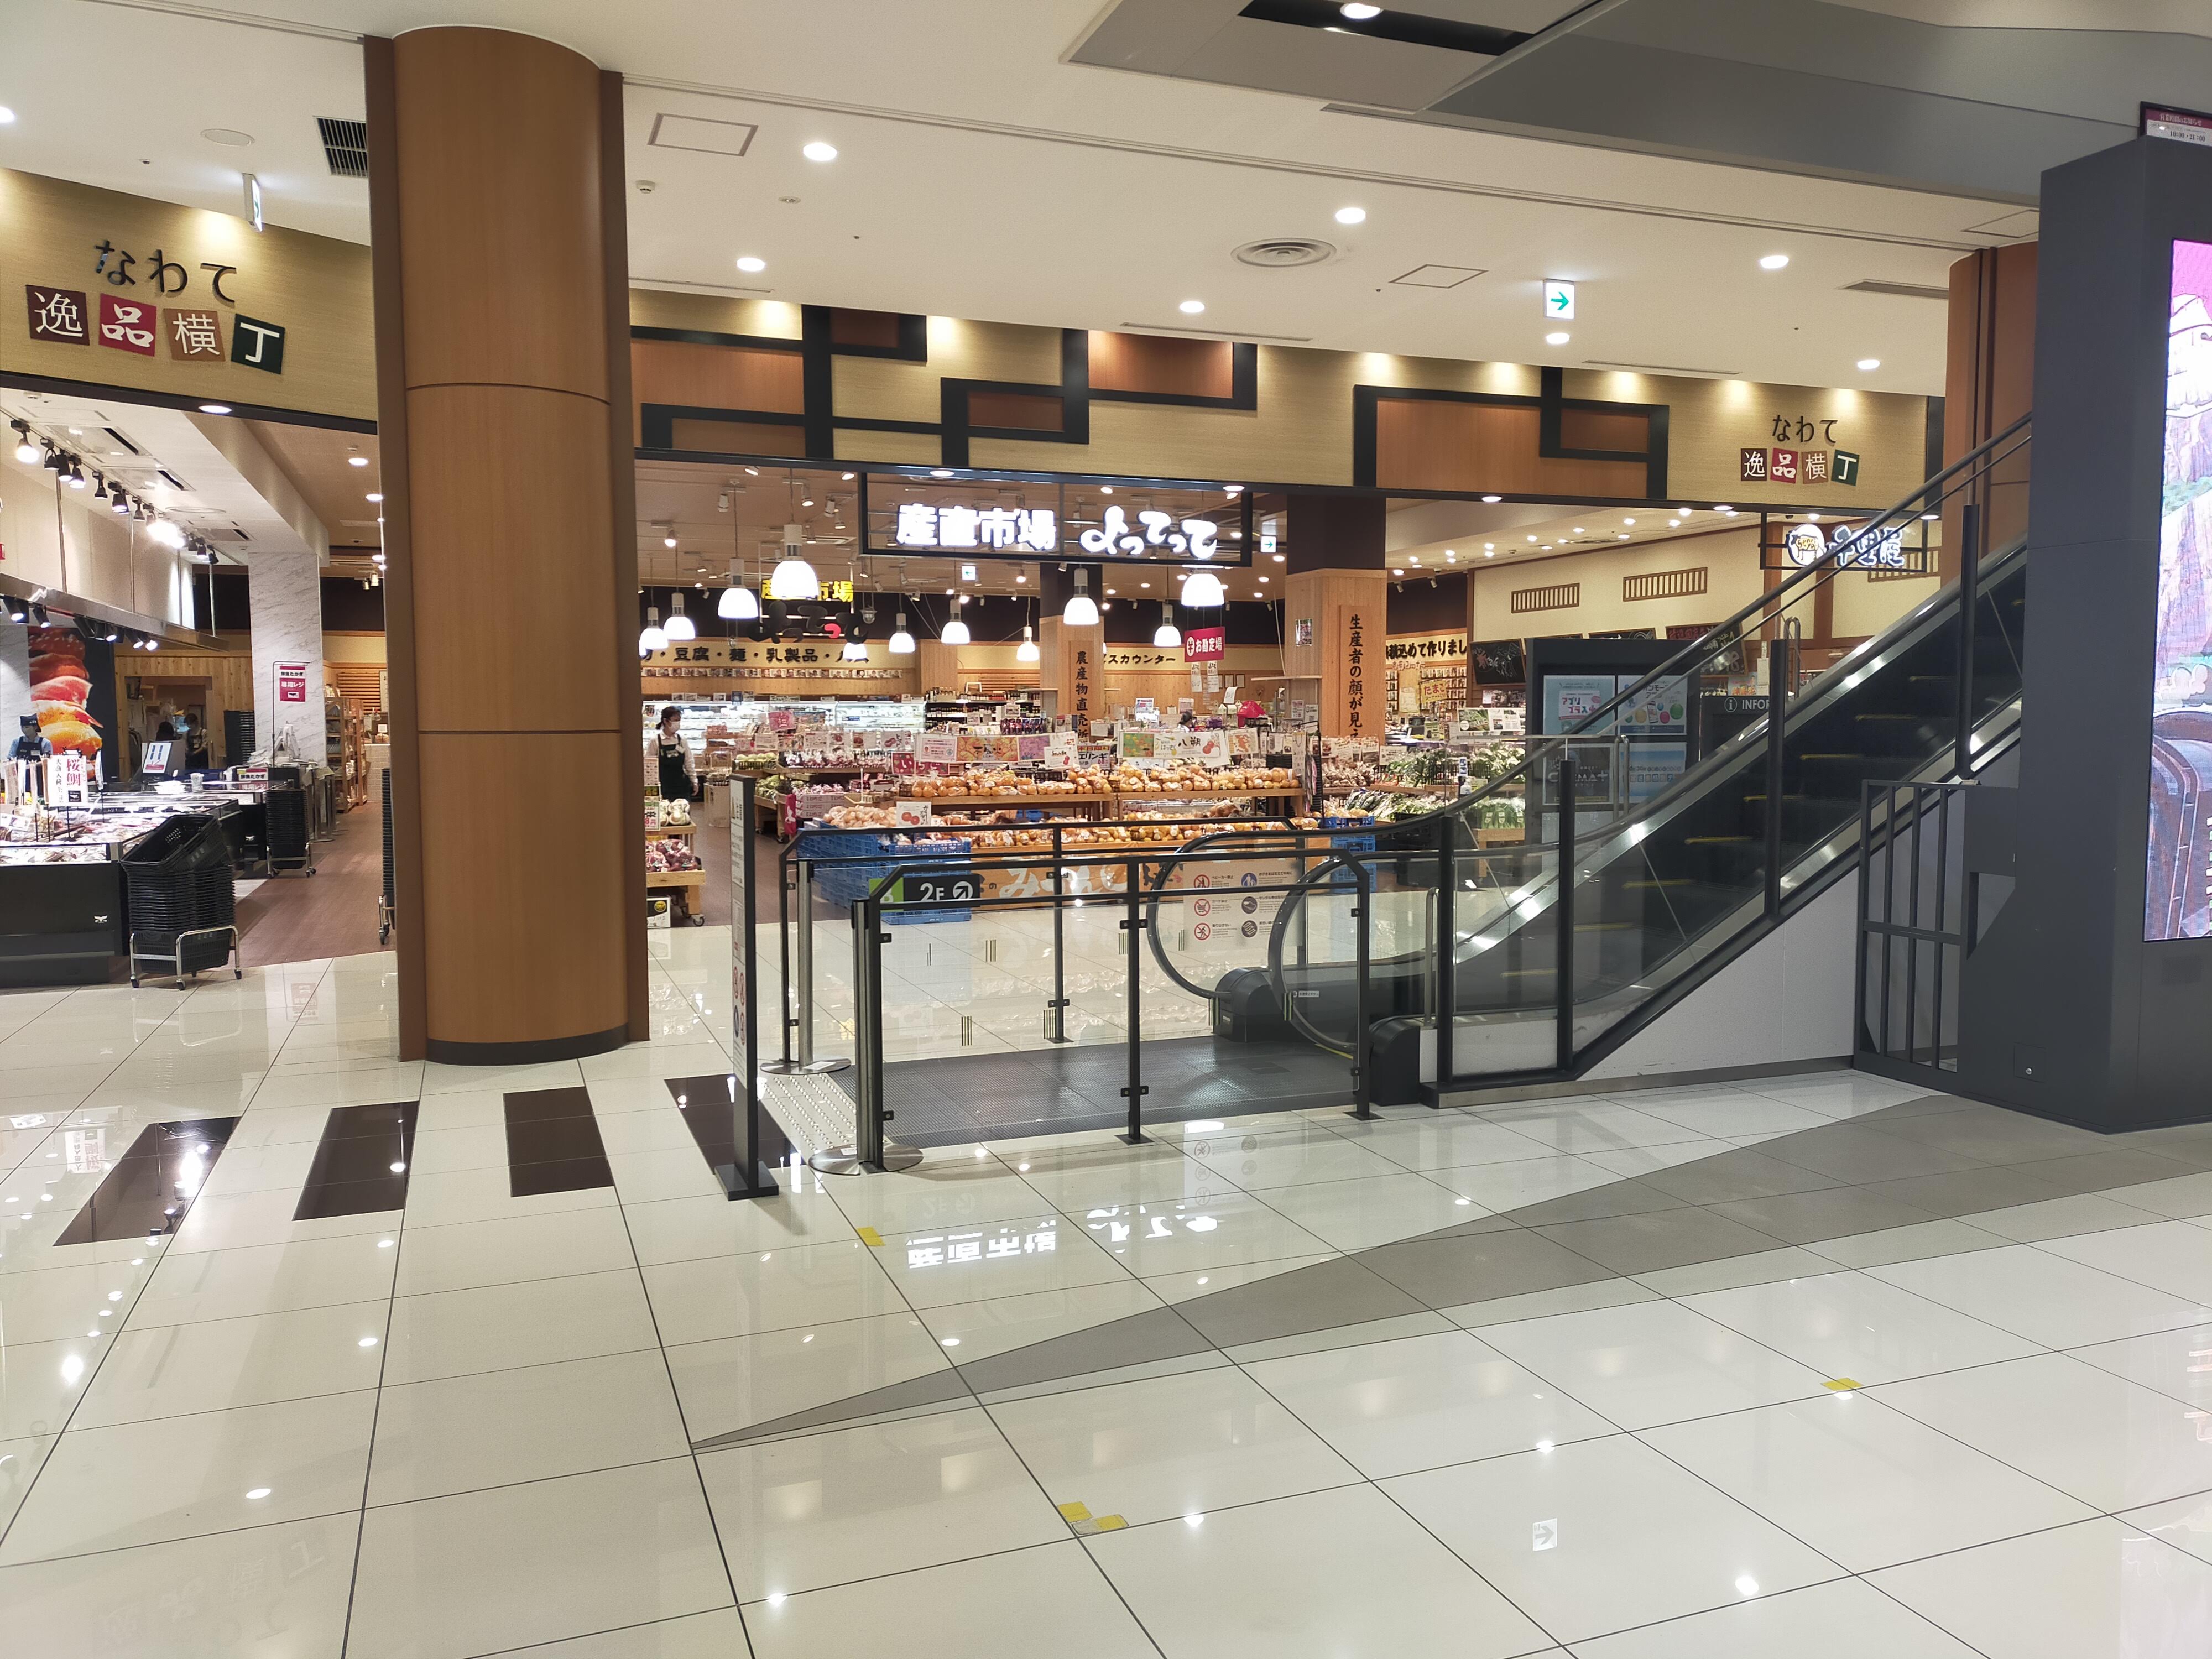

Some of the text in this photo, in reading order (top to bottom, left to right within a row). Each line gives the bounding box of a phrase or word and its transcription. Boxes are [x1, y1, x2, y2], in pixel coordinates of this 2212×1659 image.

[95, 239, 237, 304] なわて
[34, 291, 280, 364] 逸品横丁
[1772, 414, 1839, 444] なわて
[1743, 450, 1858, 482] 逸品横丁
[895, 502, 1218, 559] 産直市場 よってって
[1195, 636, 1223, 653] お勘定場
[1078, 752, 1108, 760] エリンギ
[920, 882, 945, 902] 2F
